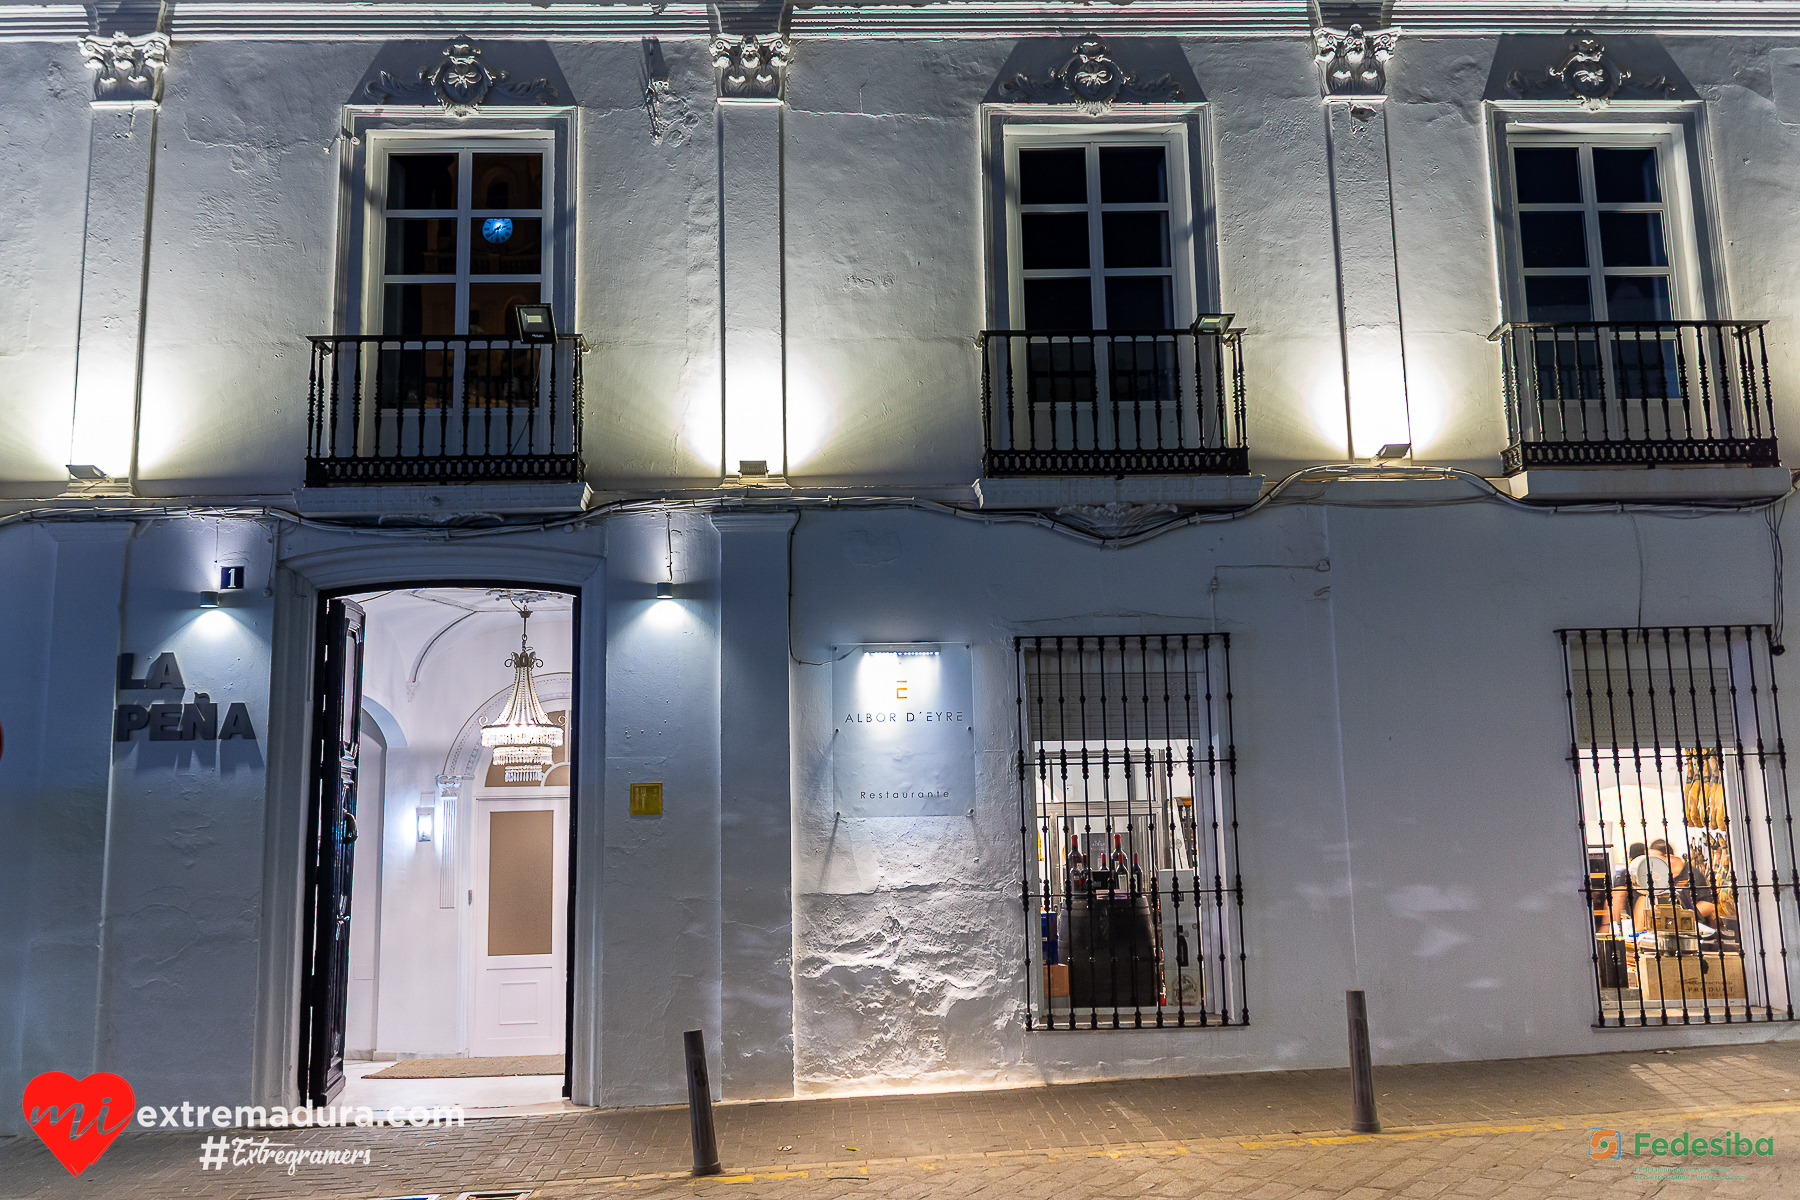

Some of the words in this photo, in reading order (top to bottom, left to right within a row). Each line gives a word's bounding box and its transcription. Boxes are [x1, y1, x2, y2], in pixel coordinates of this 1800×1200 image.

[227, 568, 237, 588] 1
[119, 652, 186, 690] LA
[116, 692, 257, 742] PEÑA
[844, 712, 897, 723] ALBOR
[860, 790, 950, 799] Restaurante
